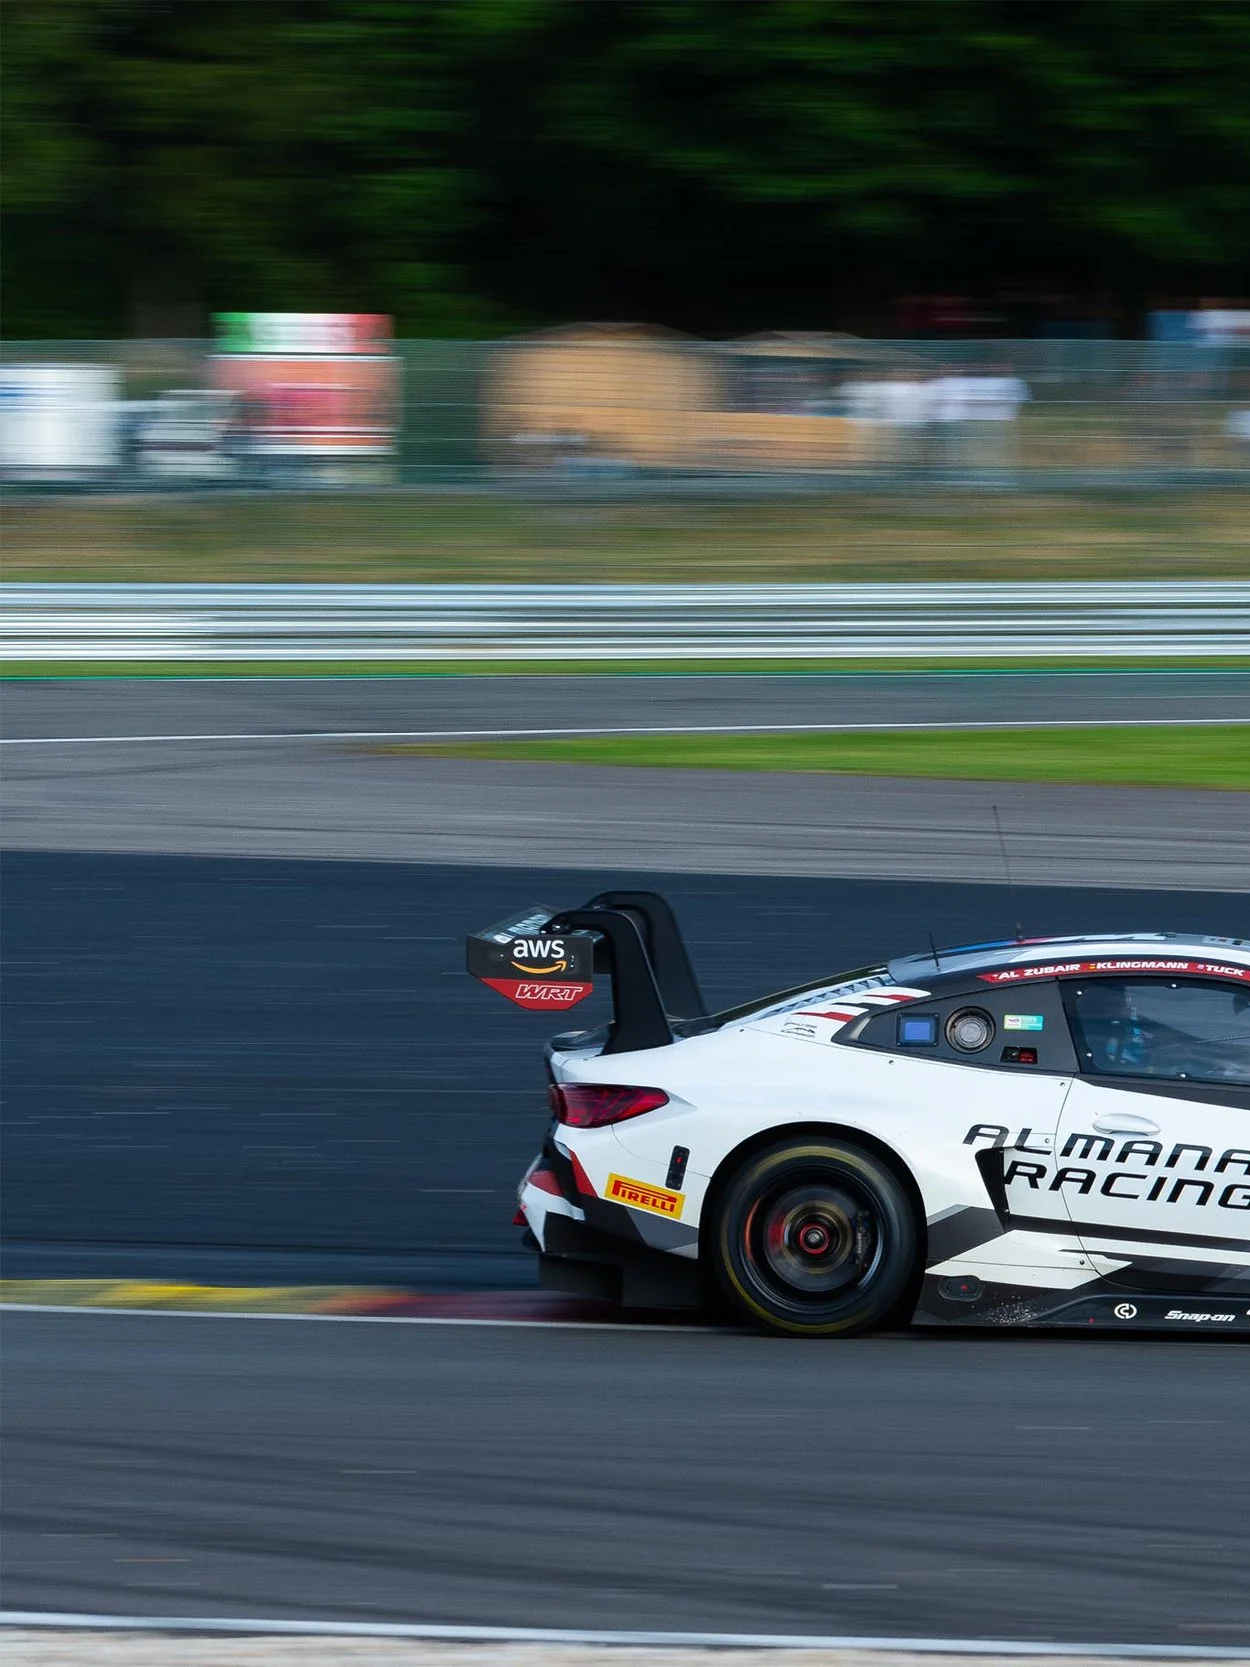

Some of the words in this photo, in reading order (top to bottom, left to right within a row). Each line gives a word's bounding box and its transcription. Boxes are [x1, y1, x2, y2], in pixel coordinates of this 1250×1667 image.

[513, 939, 565, 958] aws
[999, 972, 1019, 980] AL
[1023, 963, 1081, 976] ZUBAIR
[1096, 960, 1189, 970] KLINGMANN
[1206, 964, 1246, 977] TUCK
[515, 984, 583, 1001] WRT
[611, 1179, 677, 1213] PIRELLI
[1164, 1310, 1236, 1322] Snap-on
